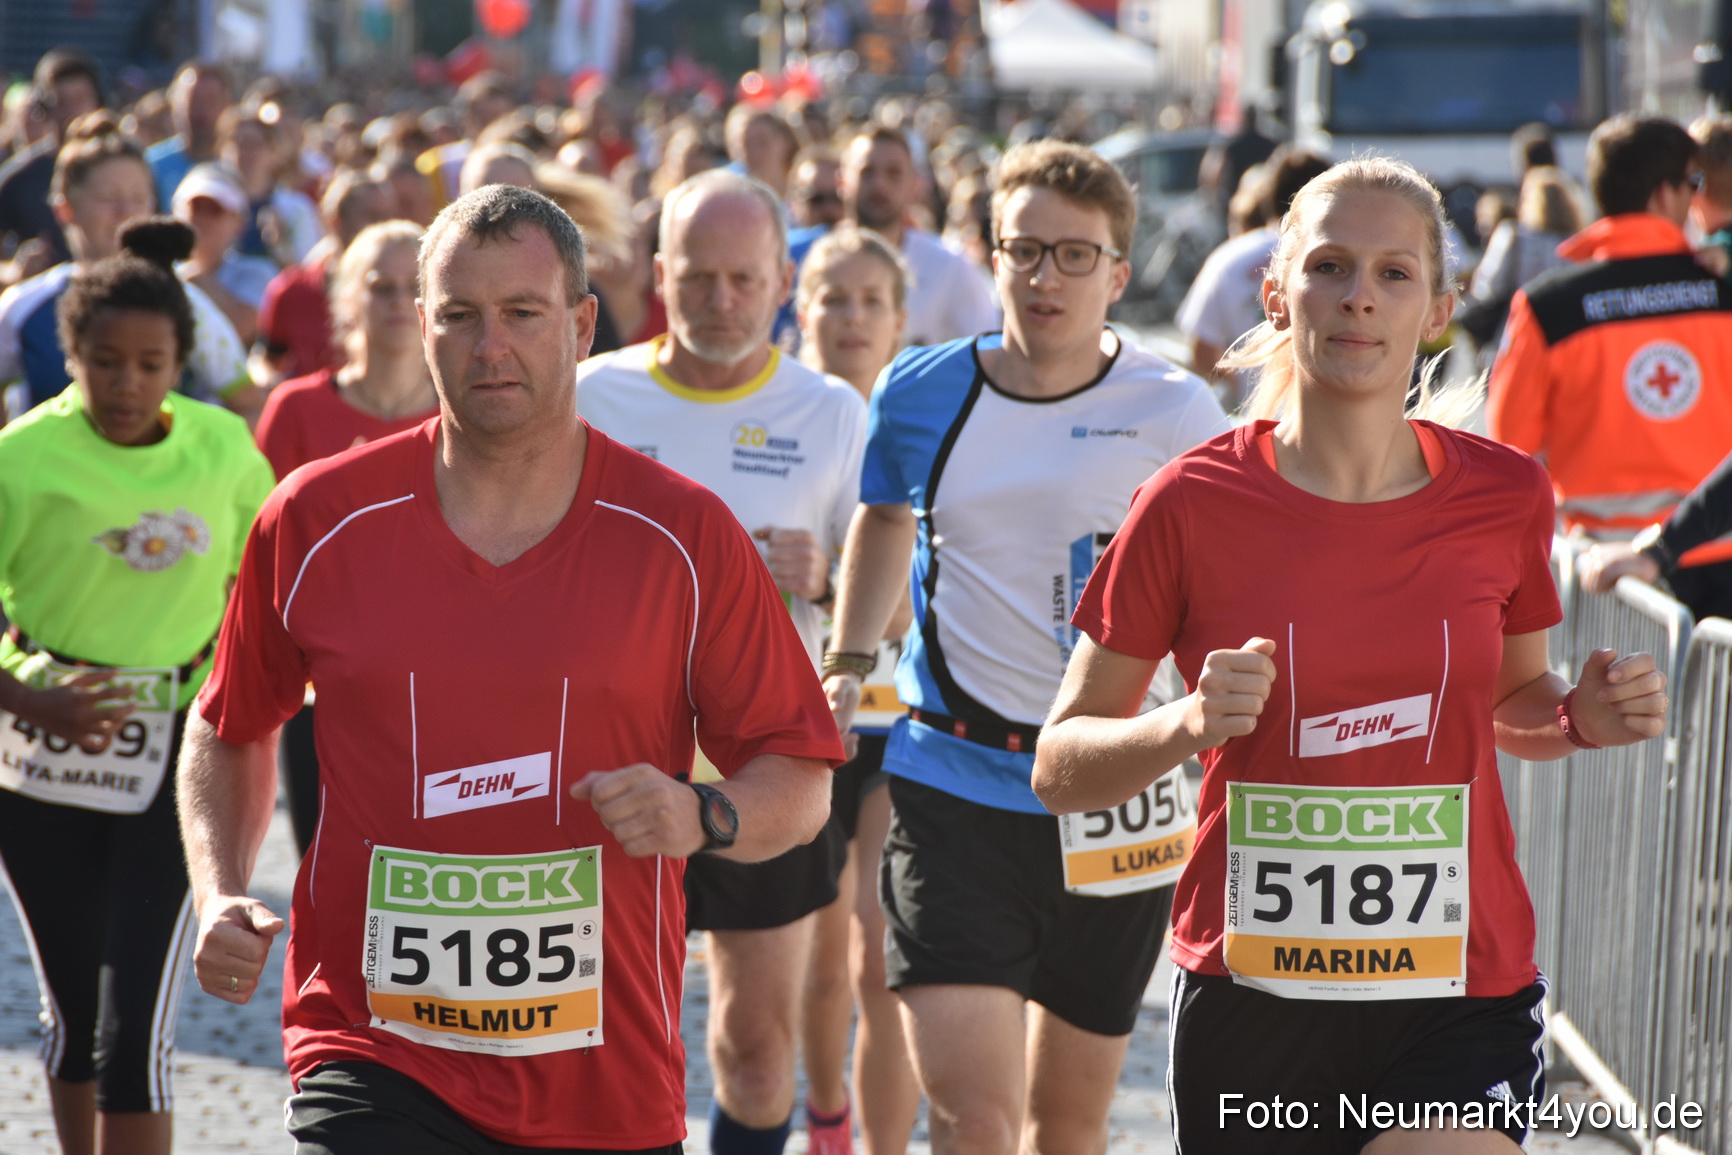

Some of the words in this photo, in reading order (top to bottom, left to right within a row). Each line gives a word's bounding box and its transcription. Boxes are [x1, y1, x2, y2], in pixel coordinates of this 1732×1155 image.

[1582, 279, 1718, 322] RETTUNGSDIENST
[737, 425, 766, 448] 20
[1053, 574, 1065, 622] WASTE
[1335, 713, 1395, 742] DEHN
[2, 751, 143, 794] LIYA-MARIE
[458, 772, 516, 799] DEHN
[1248, 797, 1441, 840] BOCK
[1112, 839, 1185, 874] LUKAS
[387, 861, 578, 906] BOCK
[1253, 861, 1438, 926] 5187
[390, 923, 576, 987] 5185
[1274, 947, 1416, 974] MARINA
[413, 1002, 558, 1032] HELMUT
